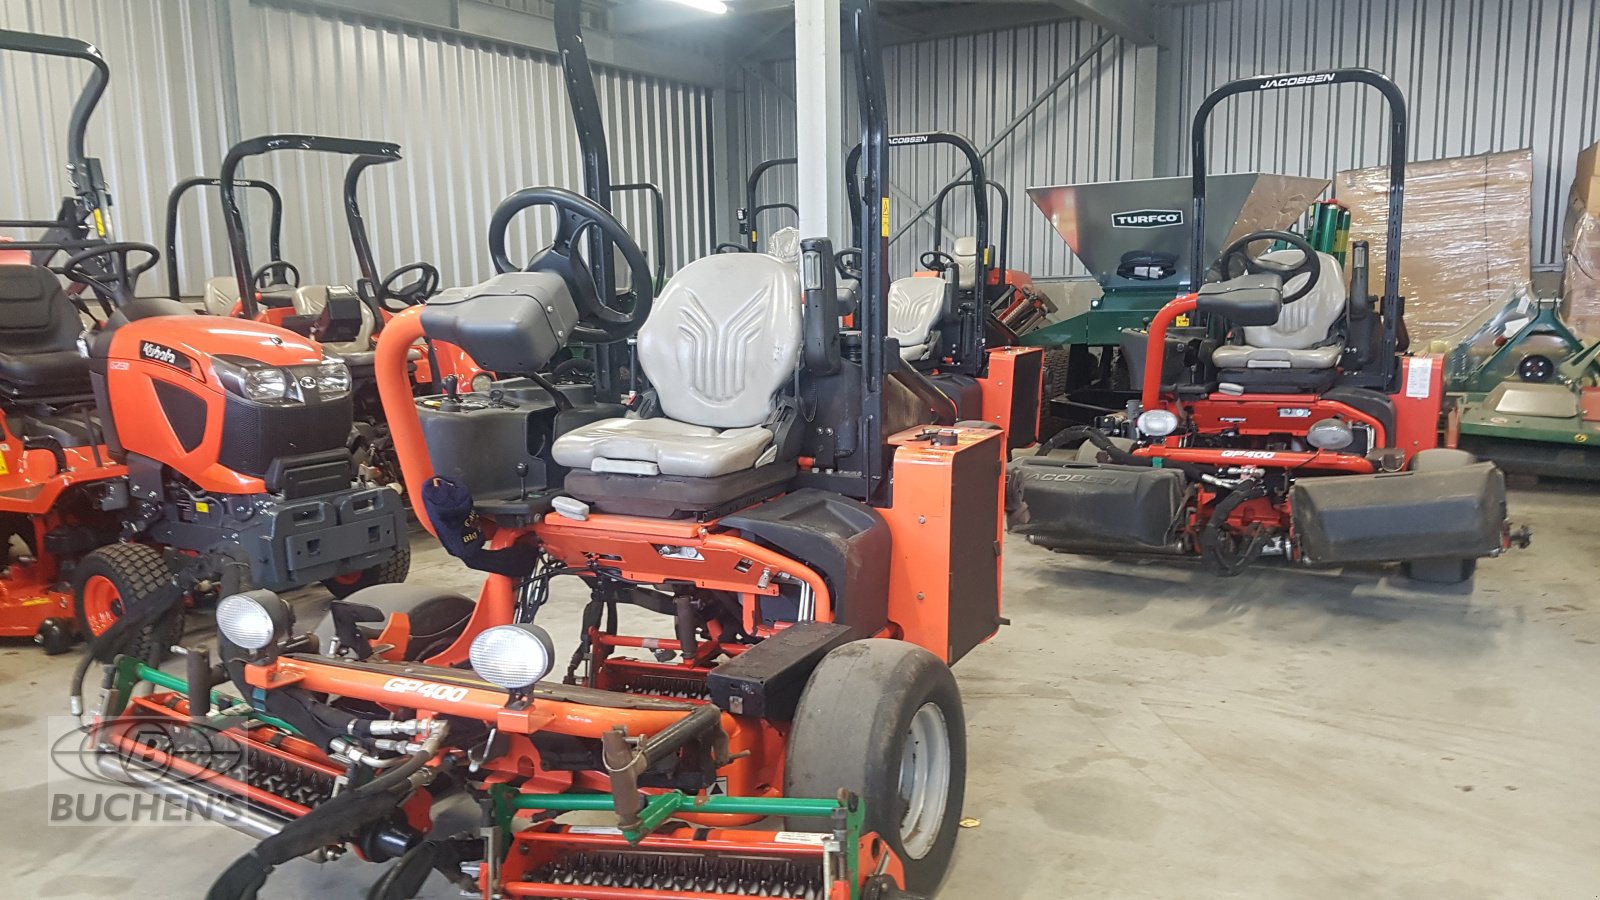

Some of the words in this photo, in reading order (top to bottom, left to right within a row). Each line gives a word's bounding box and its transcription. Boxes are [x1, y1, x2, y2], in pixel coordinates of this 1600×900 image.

[1260, 73, 1336, 89] JACOBSEN
[888, 136, 928, 144] ACOBSEN
[1116, 214, 1179, 224] TURFCO
[142, 342, 176, 364] Kubota
[1220, 450, 1276, 459] GP400
[383, 677, 469, 703] GP400
